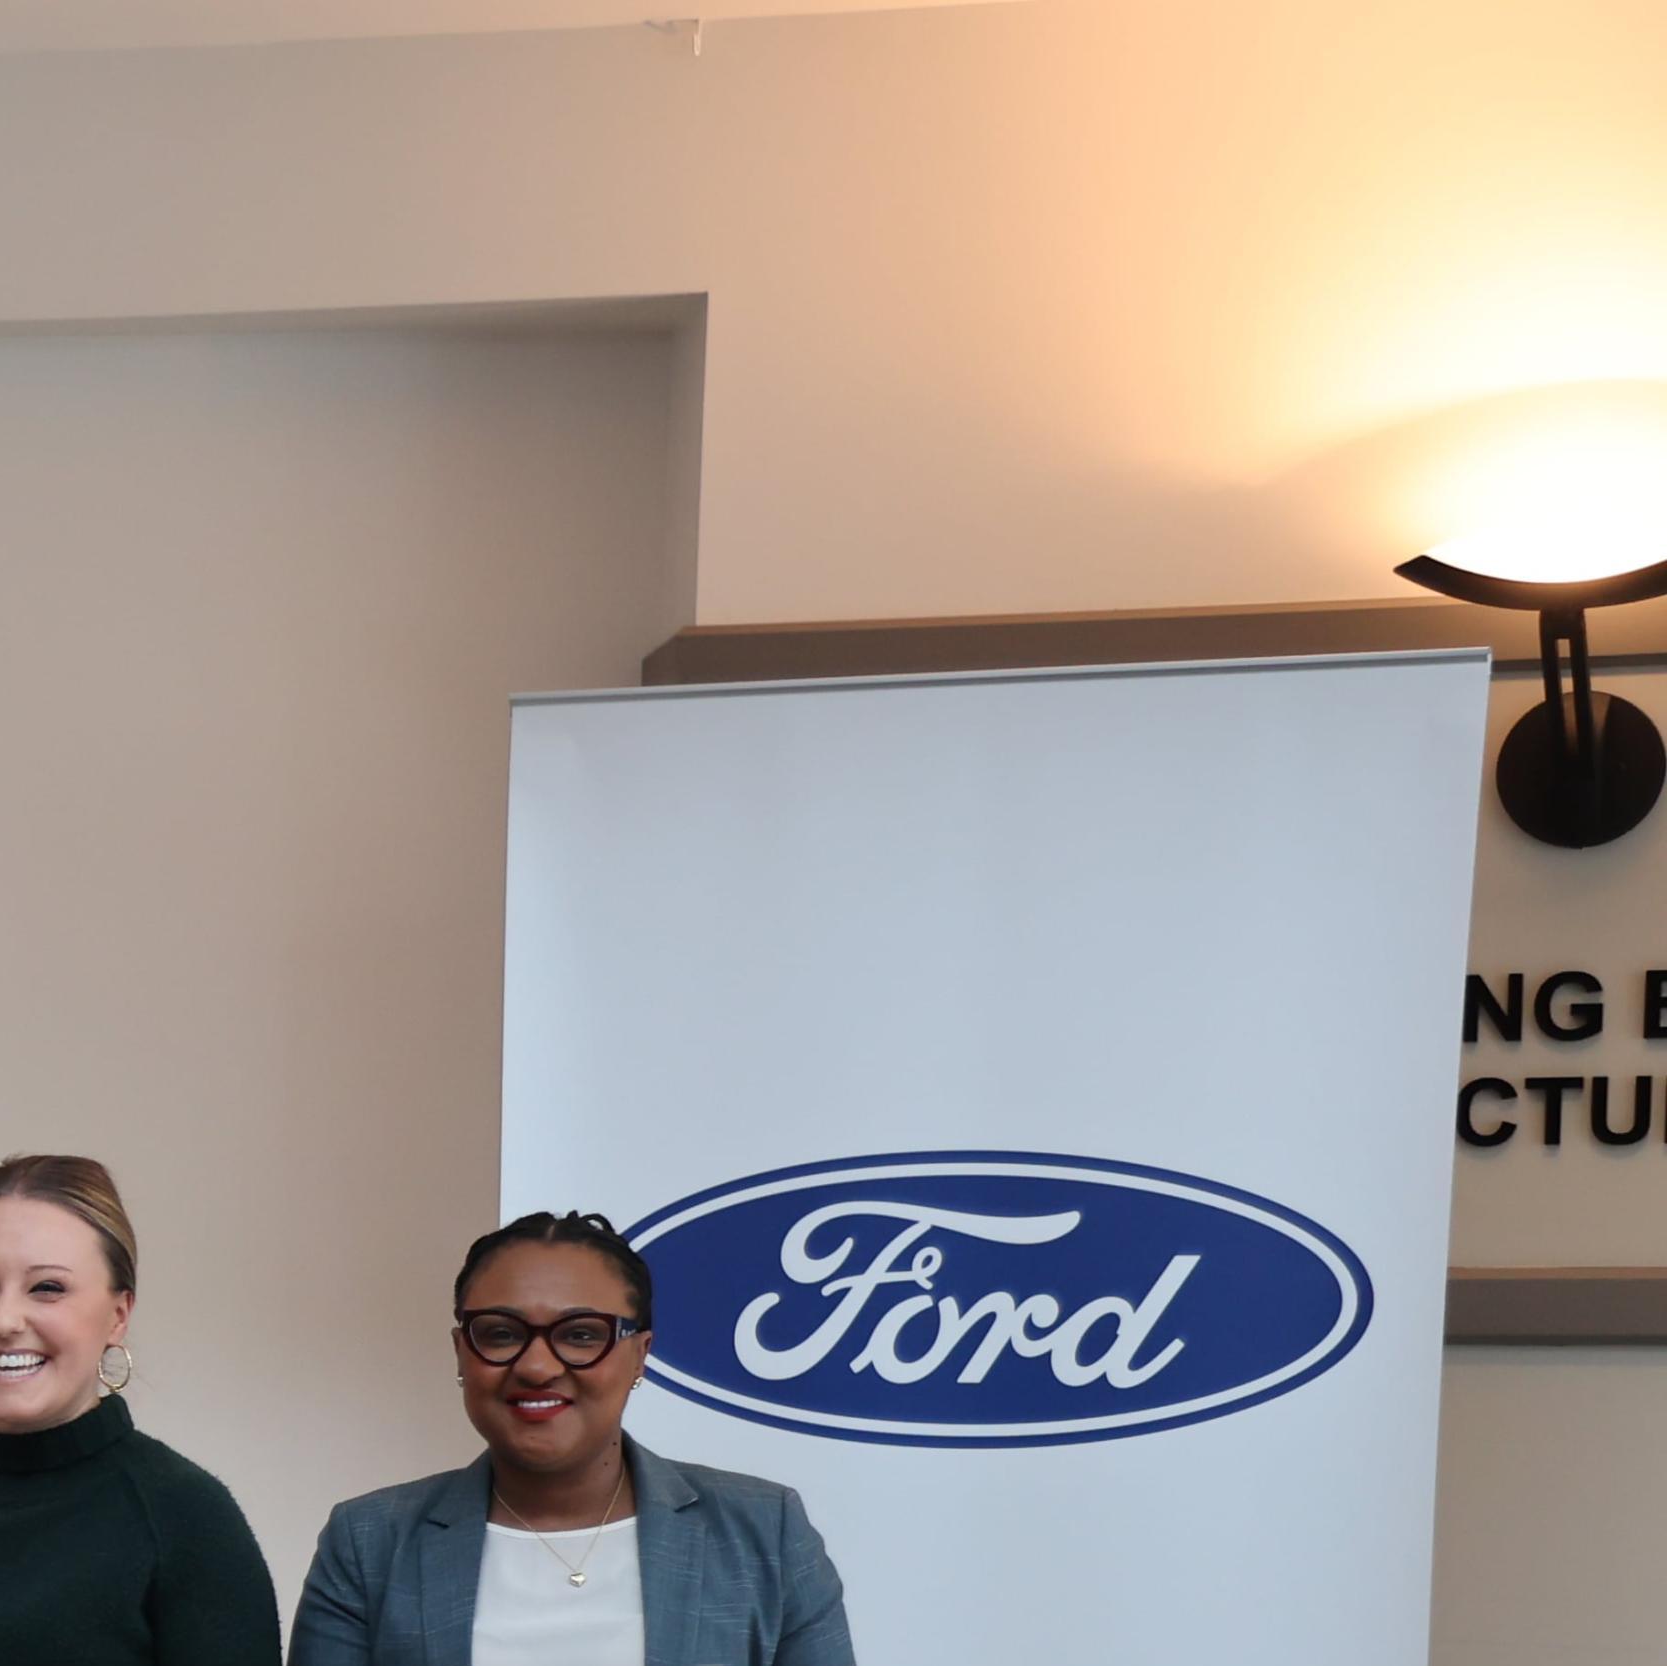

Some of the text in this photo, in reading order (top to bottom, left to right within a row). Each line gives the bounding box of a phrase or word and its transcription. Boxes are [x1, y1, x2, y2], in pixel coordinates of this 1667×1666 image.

[1462, 970, 1604, 1043] NG
[1456, 1075, 1667, 1148] CTU
[733, 1200, 1202, 1389] Ford
